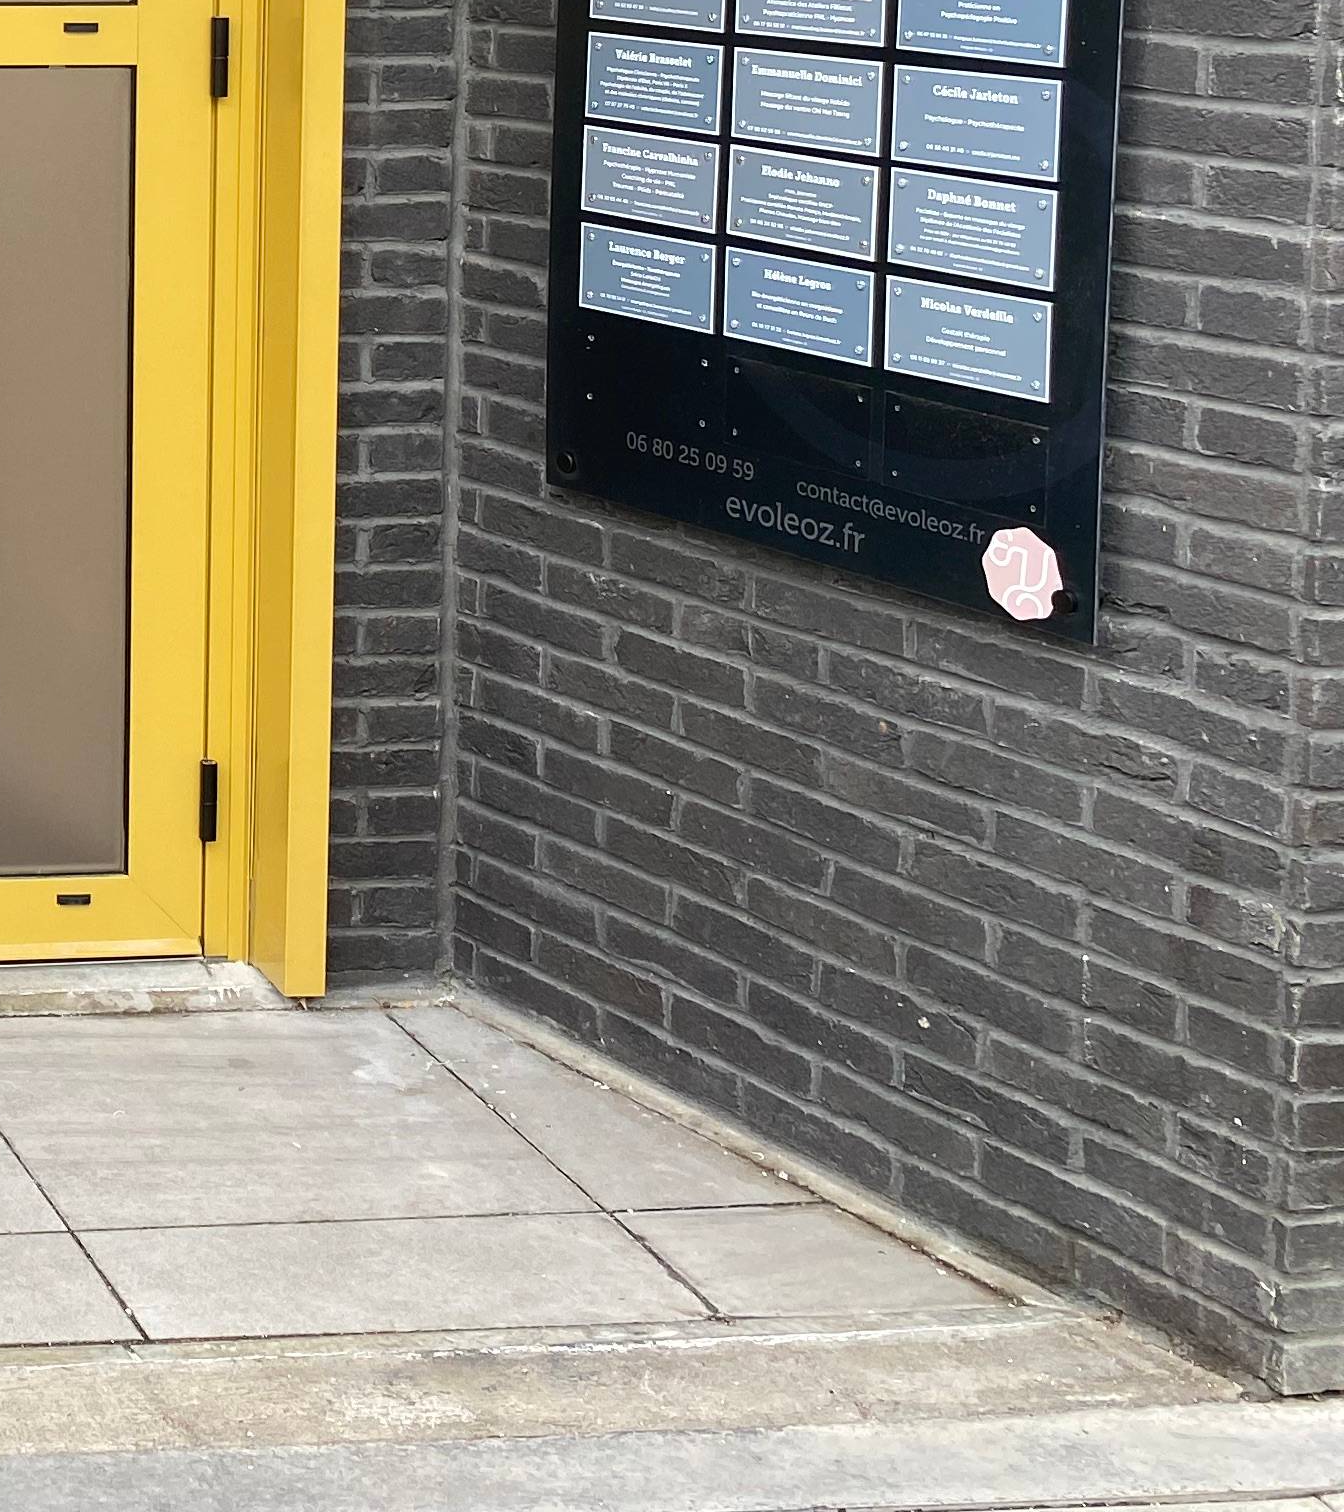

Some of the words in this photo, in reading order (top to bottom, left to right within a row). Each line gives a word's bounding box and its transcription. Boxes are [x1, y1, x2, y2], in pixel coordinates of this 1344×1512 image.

[615, 49, 647, 64] Valérie
[814, 69, 862, 86] Dominici
[933, 84, 967, 99] Cécile
[602, 142, 641, 160] Francine
[643, 148, 699, 166] Carvalhinha
[762, 165, 793, 180] Elodie
[928, 188, 972, 206] Daphné
[974, 196, 1017, 213] Bonnet
[609, 241, 652, 259] Laurence
[654, 249, 686, 265] Berger
[764, 268, 797, 284] Hélène
[799, 274, 832, 291] Legros
[920, 297, 963, 314] Nicolas
[626, 431, 647, 454] 06
[653, 437, 674, 460] 80
[678, 443, 700, 467] 25
[706, 451, 728, 474] 09
[733, 458, 755, 482] 59
[796, 478, 985, 546] contact@evoleoz.fr
[726, 494, 865, 554] evoleoz.fr
